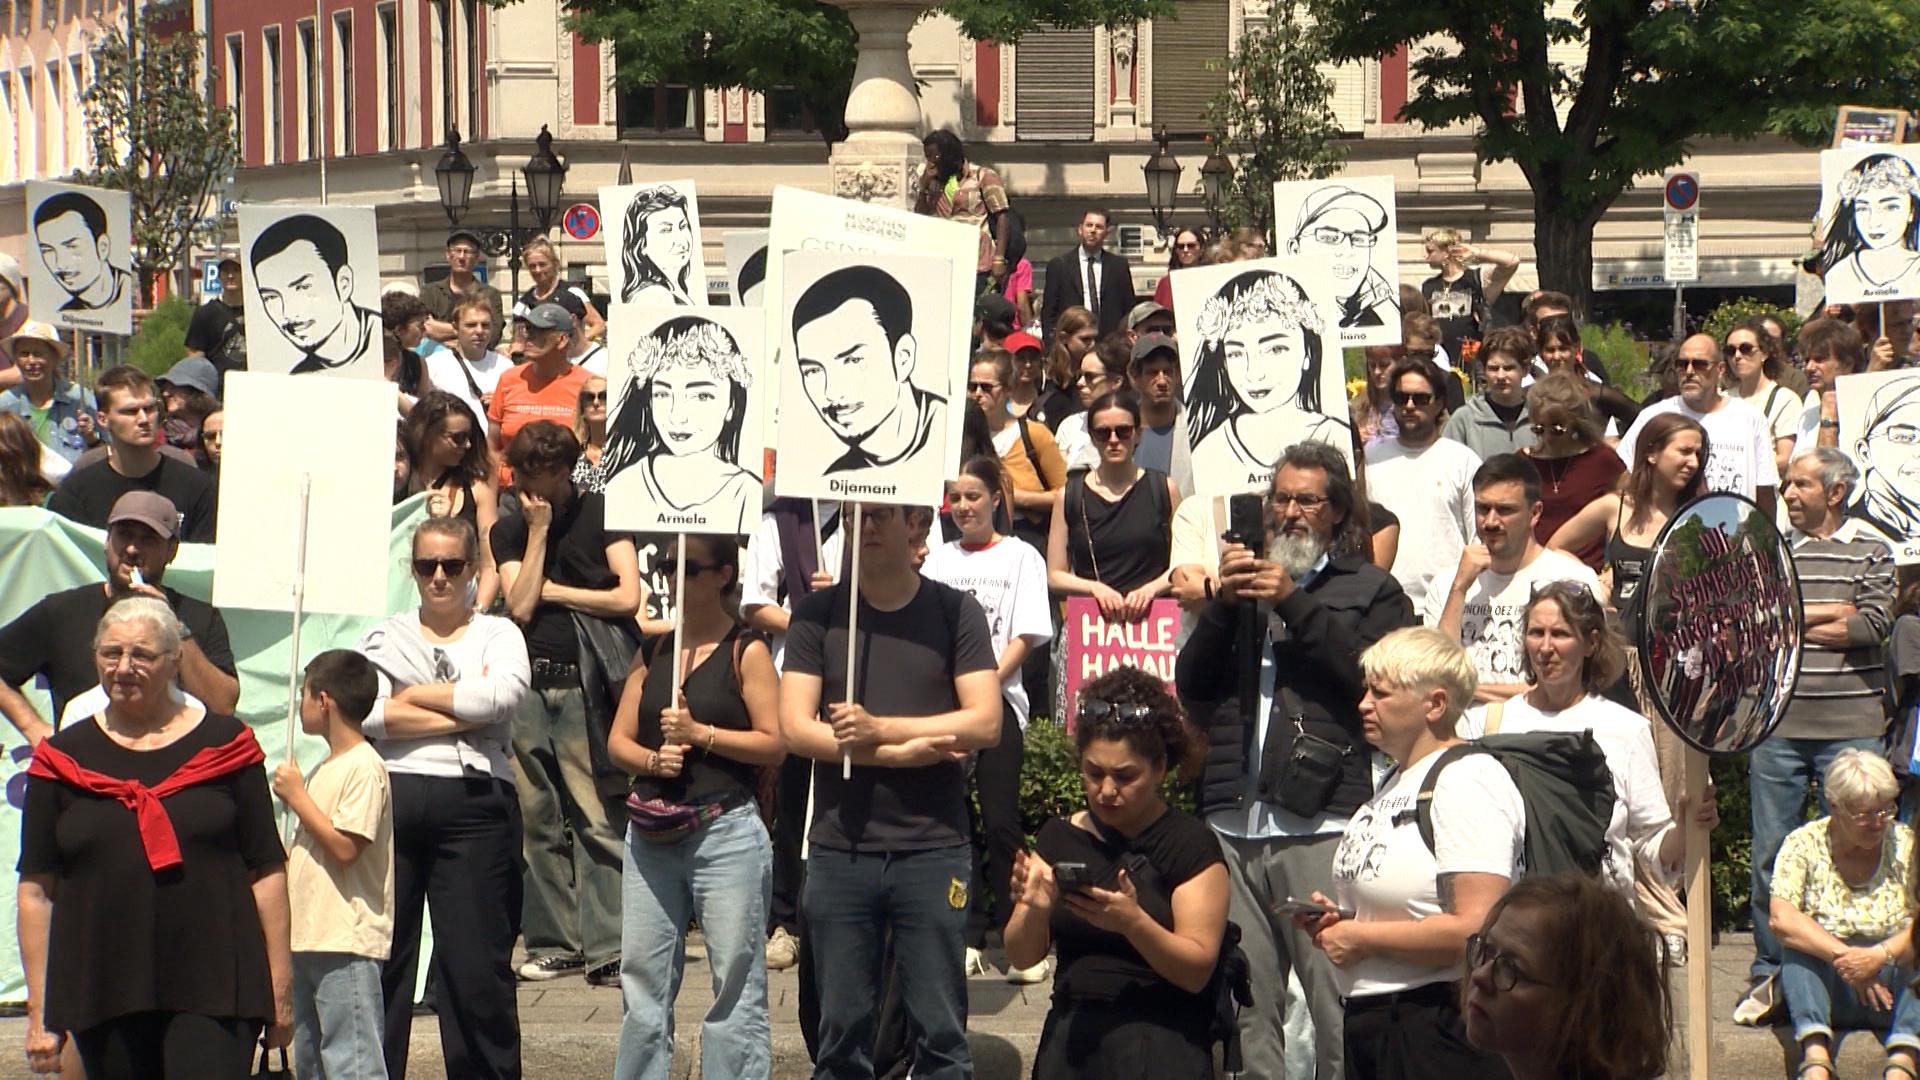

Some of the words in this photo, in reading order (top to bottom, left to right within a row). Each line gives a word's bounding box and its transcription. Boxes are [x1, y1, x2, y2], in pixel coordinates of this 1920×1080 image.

[207, 265, 219, 290] P
[1340, 331, 1367, 340] liano
[829, 479, 897, 496] Dijamant
[657, 513, 707, 524] Armela
[1494, 605, 1512, 616] OEZ
[1081, 612, 1176, 651] HALLE
